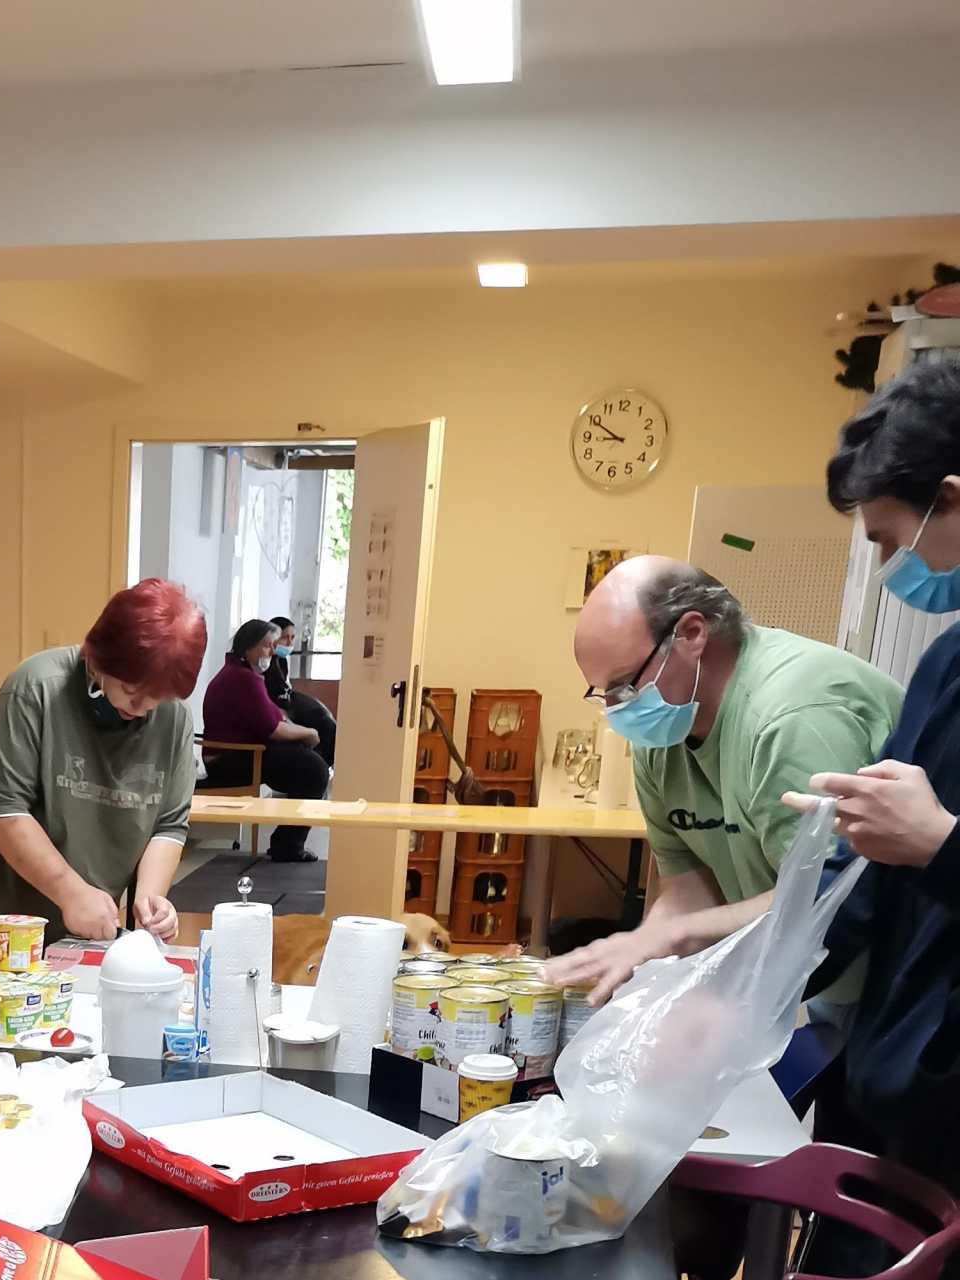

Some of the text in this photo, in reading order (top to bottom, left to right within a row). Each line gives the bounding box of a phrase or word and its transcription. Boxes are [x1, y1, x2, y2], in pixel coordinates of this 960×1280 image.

[603, 403, 613, 415] 11
[619, 399, 631, 412] 12
[589, 414, 602, 426] 10
[644, 418, 654, 430] 2
[583, 431, 592, 443] 9
[645, 435, 654, 447] 3
[583, 447, 593, 460] 8
[636, 451, 646, 463] 4
[595, 460, 604, 472] 7
[607, 465, 617, 478] 6
[624, 462, 633, 475] 5
[541, 1166, 565, 1196] ja!
